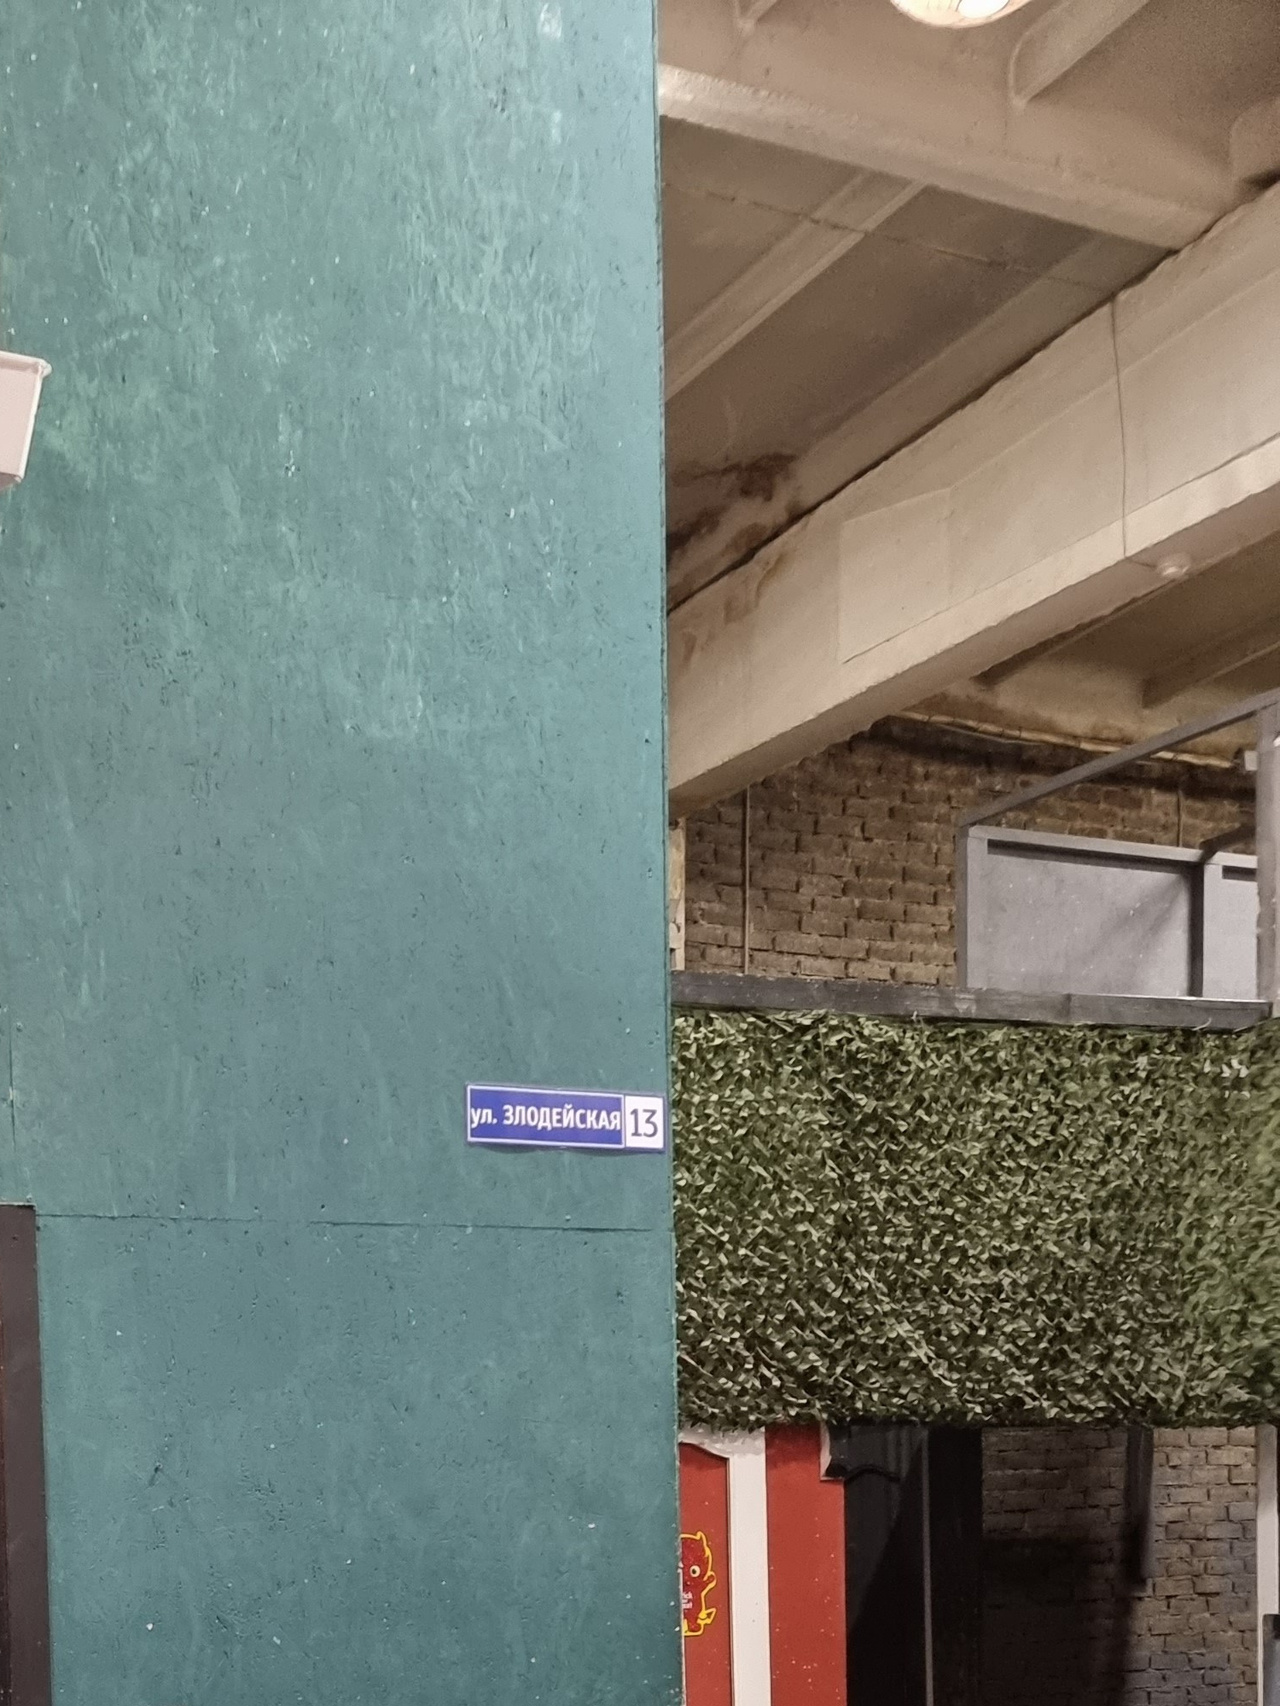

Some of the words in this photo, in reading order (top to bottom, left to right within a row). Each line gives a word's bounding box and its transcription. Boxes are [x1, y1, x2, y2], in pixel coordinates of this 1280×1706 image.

[470, 1107, 497, 1128] ул.
[503, 1104, 621, 1130] ЗЛОДЕЙСКАЯ
[630, 1108, 658, 1138] 13
